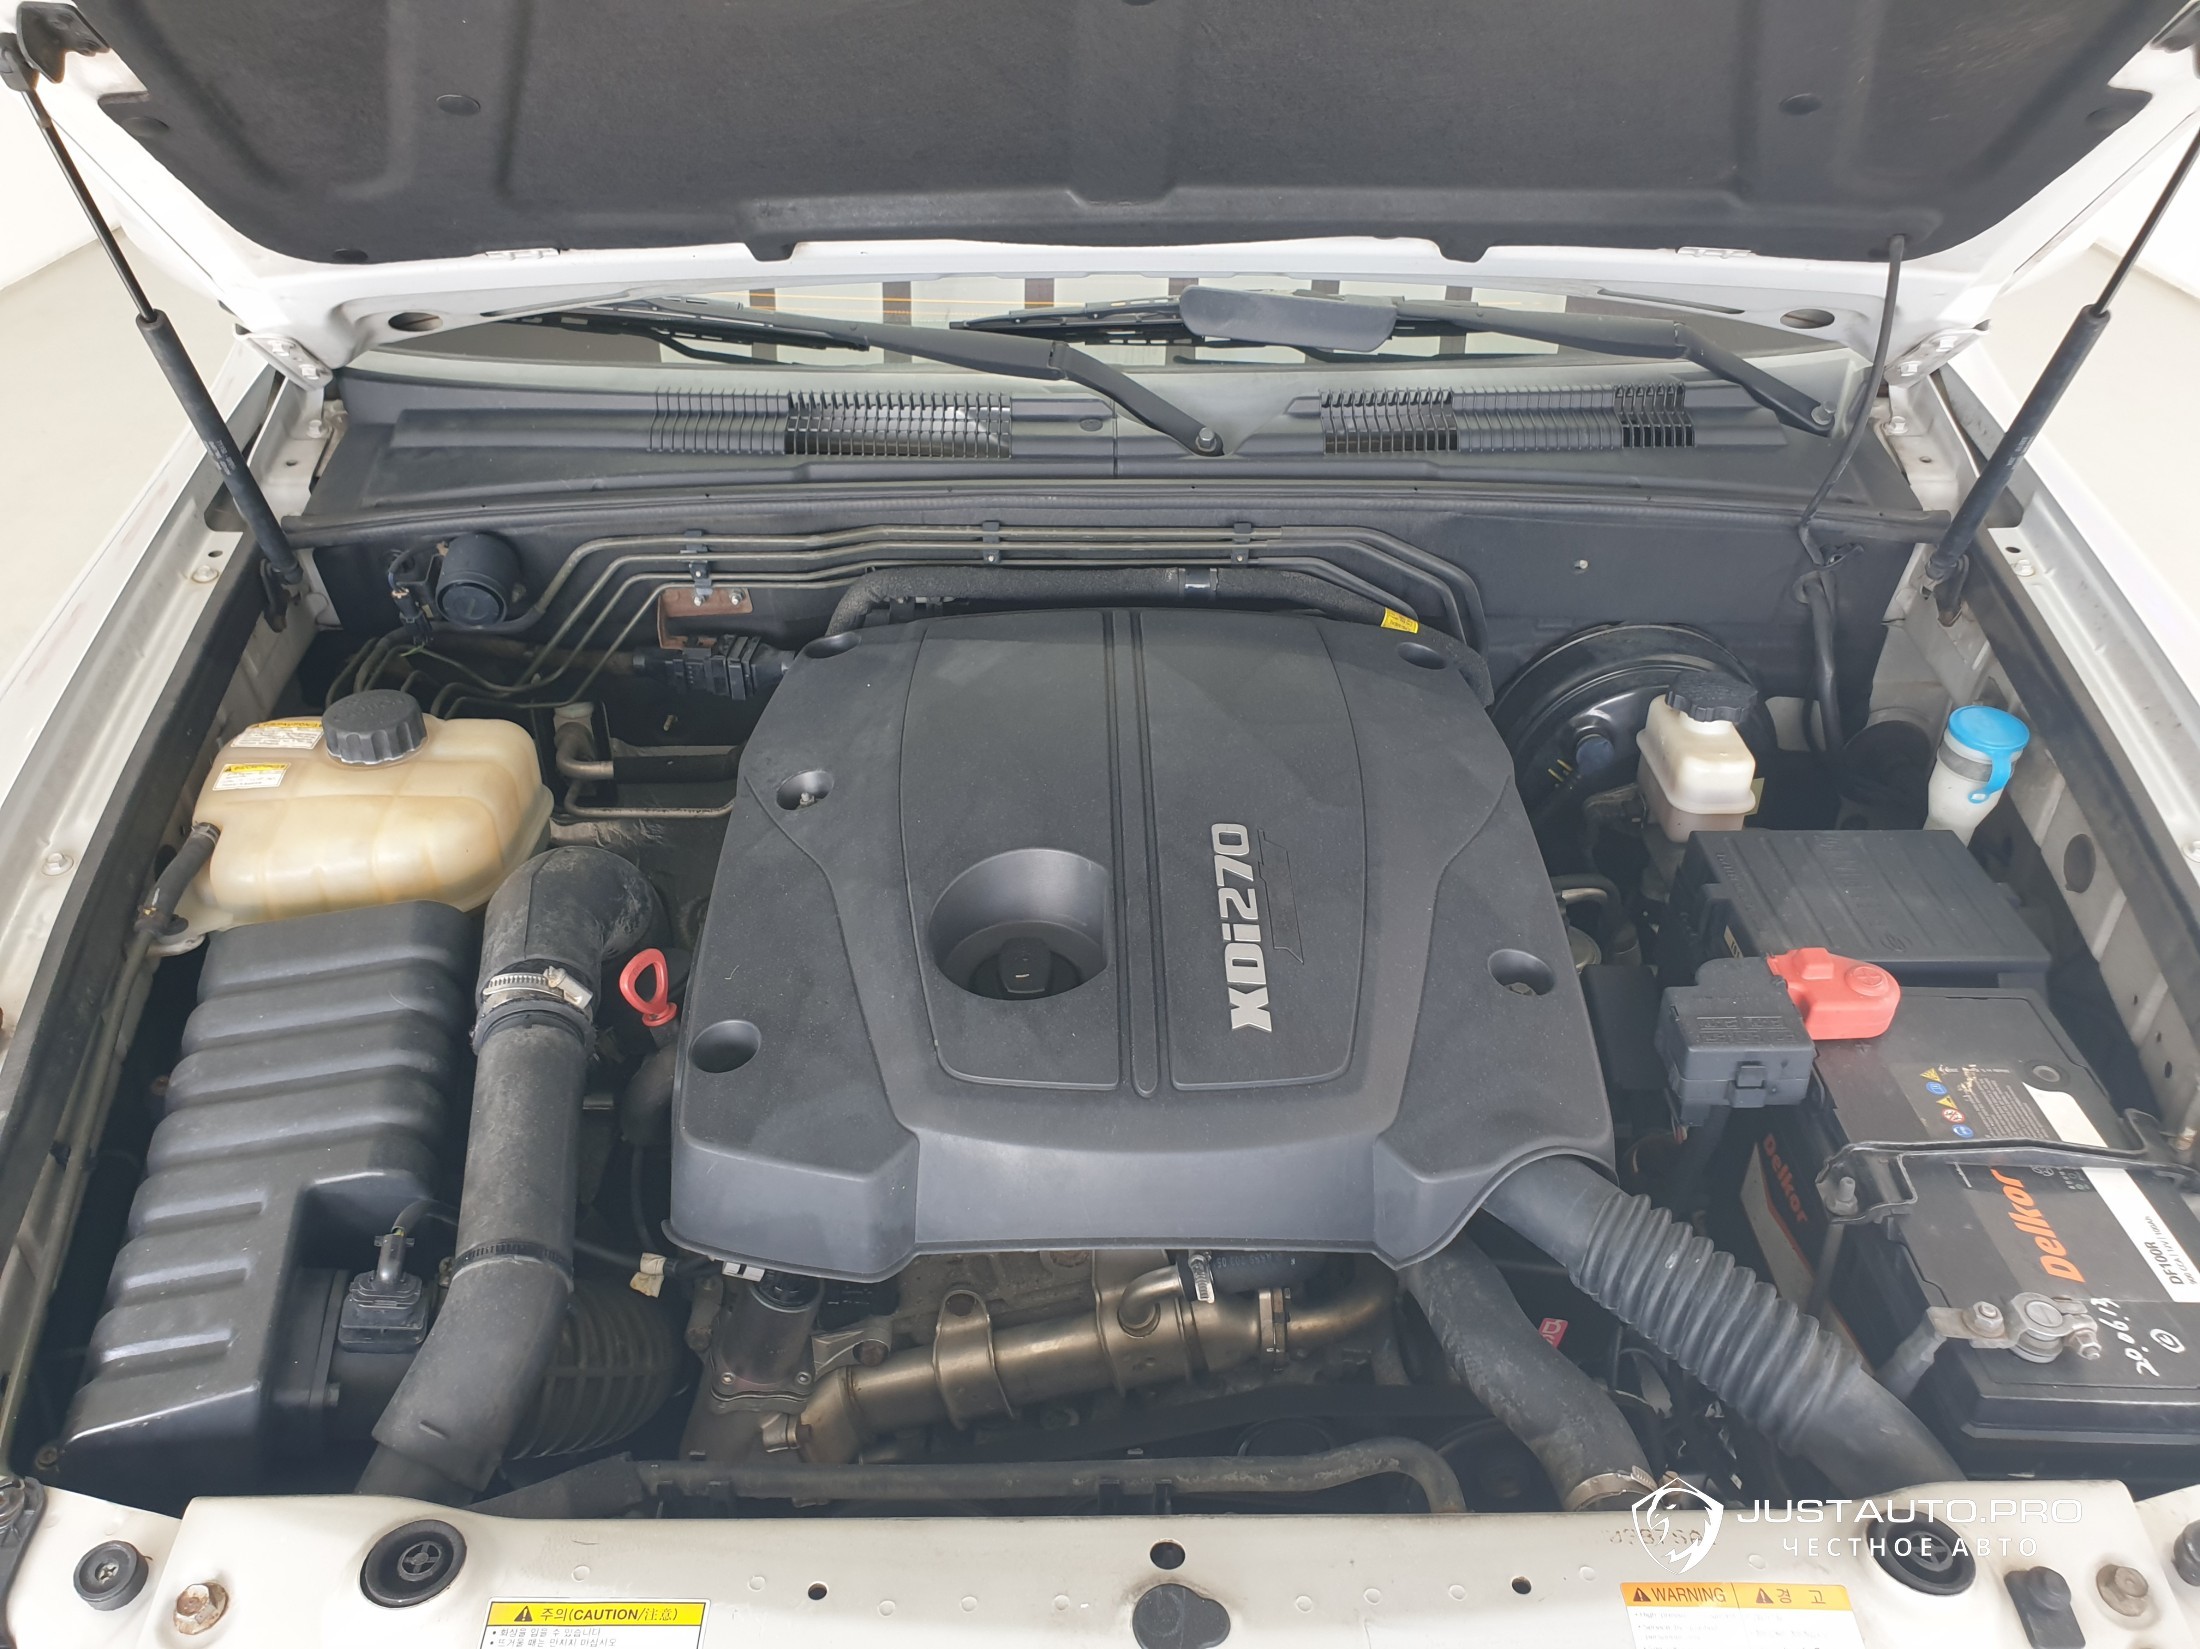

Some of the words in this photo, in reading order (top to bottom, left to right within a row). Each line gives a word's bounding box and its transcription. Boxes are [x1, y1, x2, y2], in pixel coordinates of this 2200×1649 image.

[1211, 823, 1272, 1032] XDi270
[1763, 1133, 1808, 1221] Delkor
[1990, 1167, 2086, 1283] Delkor
[2144, 1241, 2185, 1285] DF100R
[1651, 1587, 1727, 1603] WARNING
